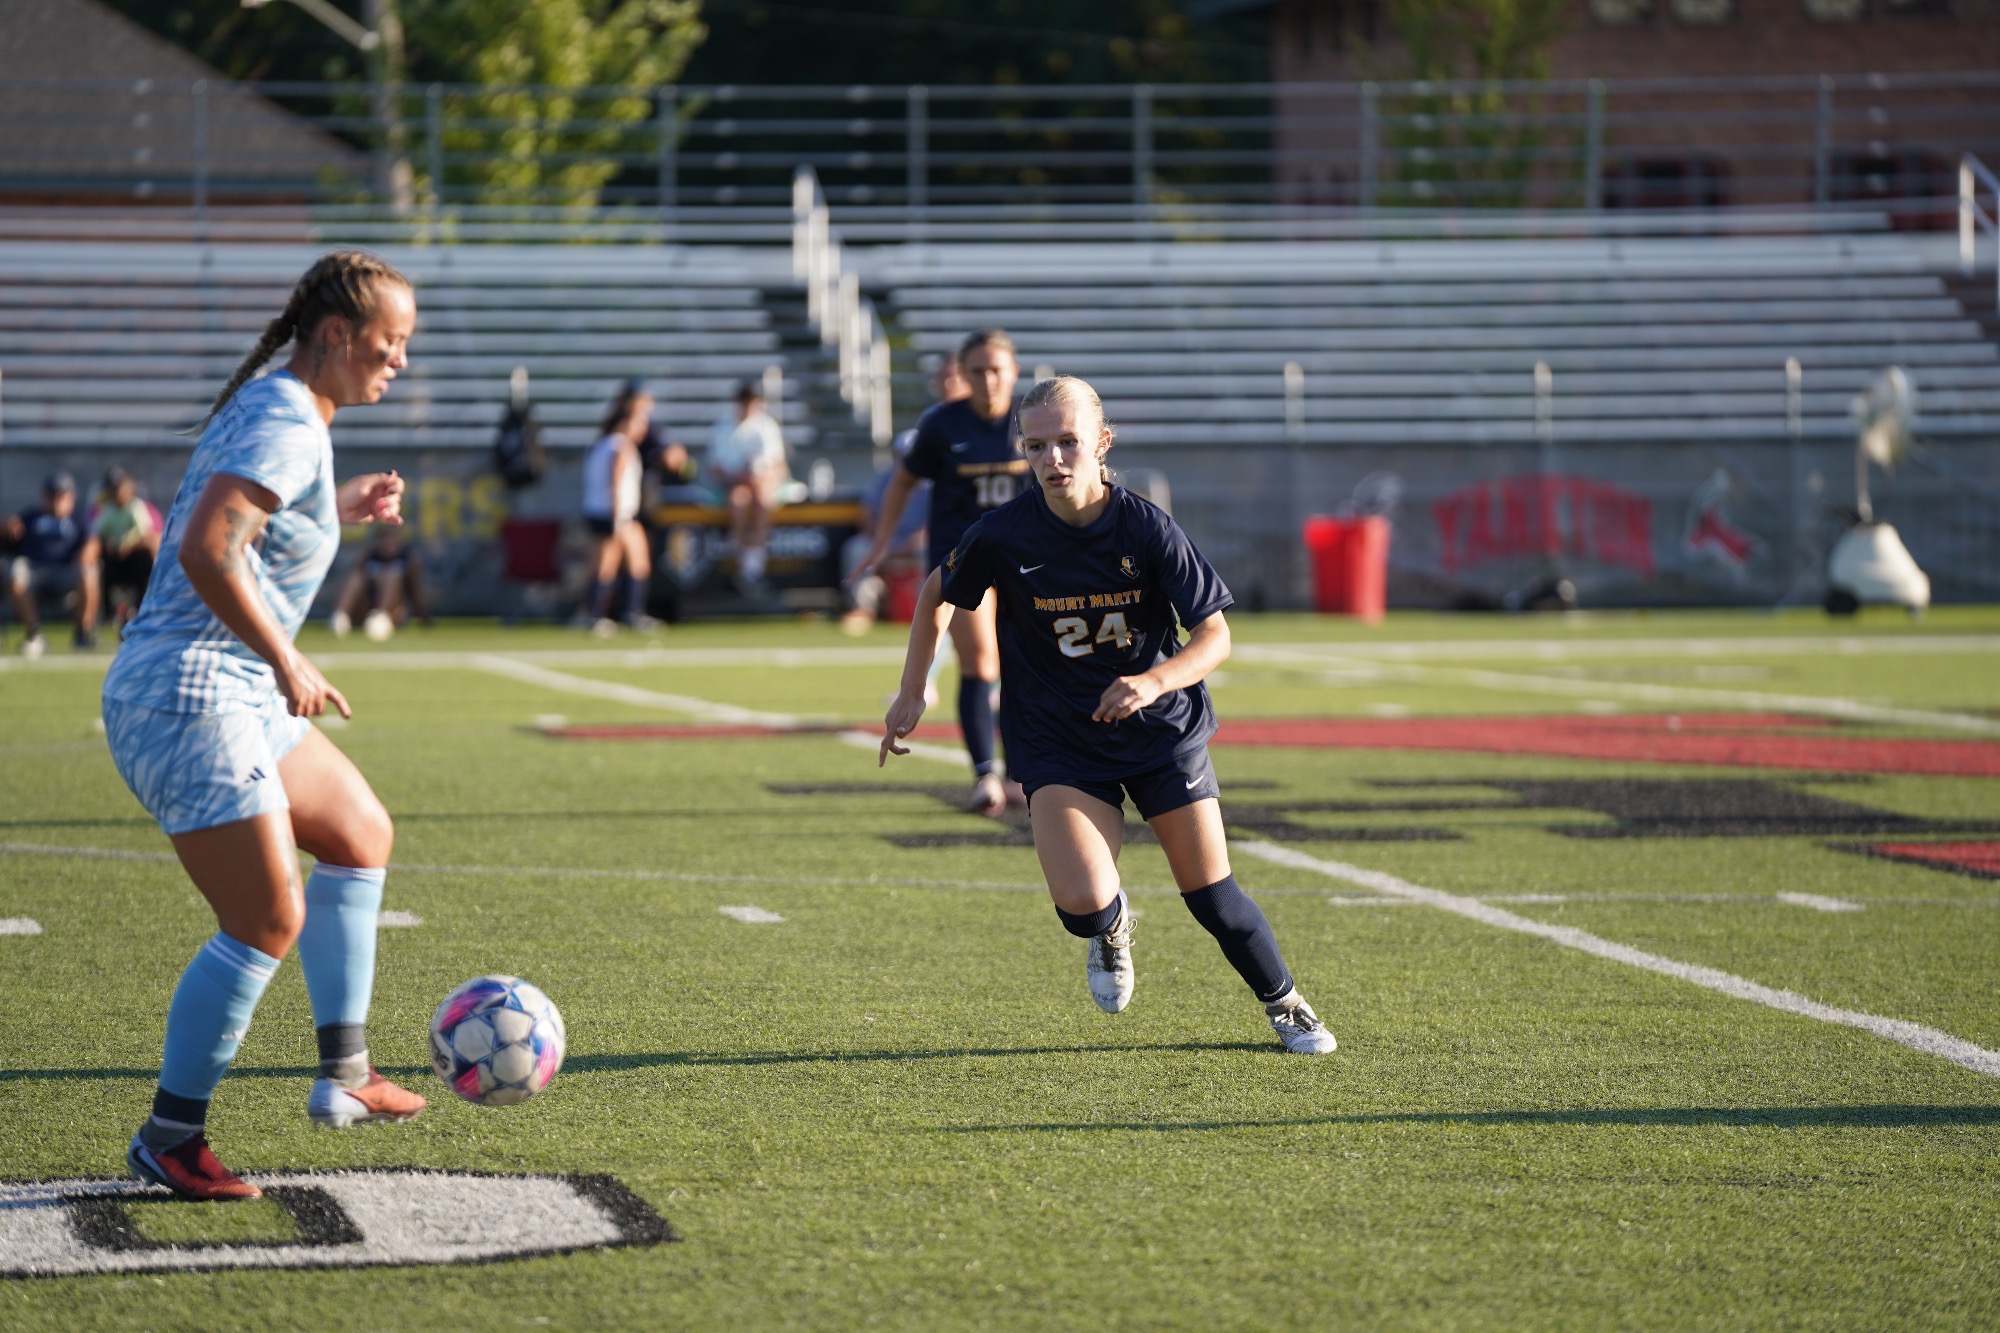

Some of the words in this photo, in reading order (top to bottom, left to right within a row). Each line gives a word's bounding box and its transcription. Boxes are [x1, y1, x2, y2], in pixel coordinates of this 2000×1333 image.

[973, 474, 1015, 507] 10
[1033, 596, 1085, 611] MOUNT
[1089, 590, 1142, 608] MARTY
[1053, 611, 1132, 658] 24
